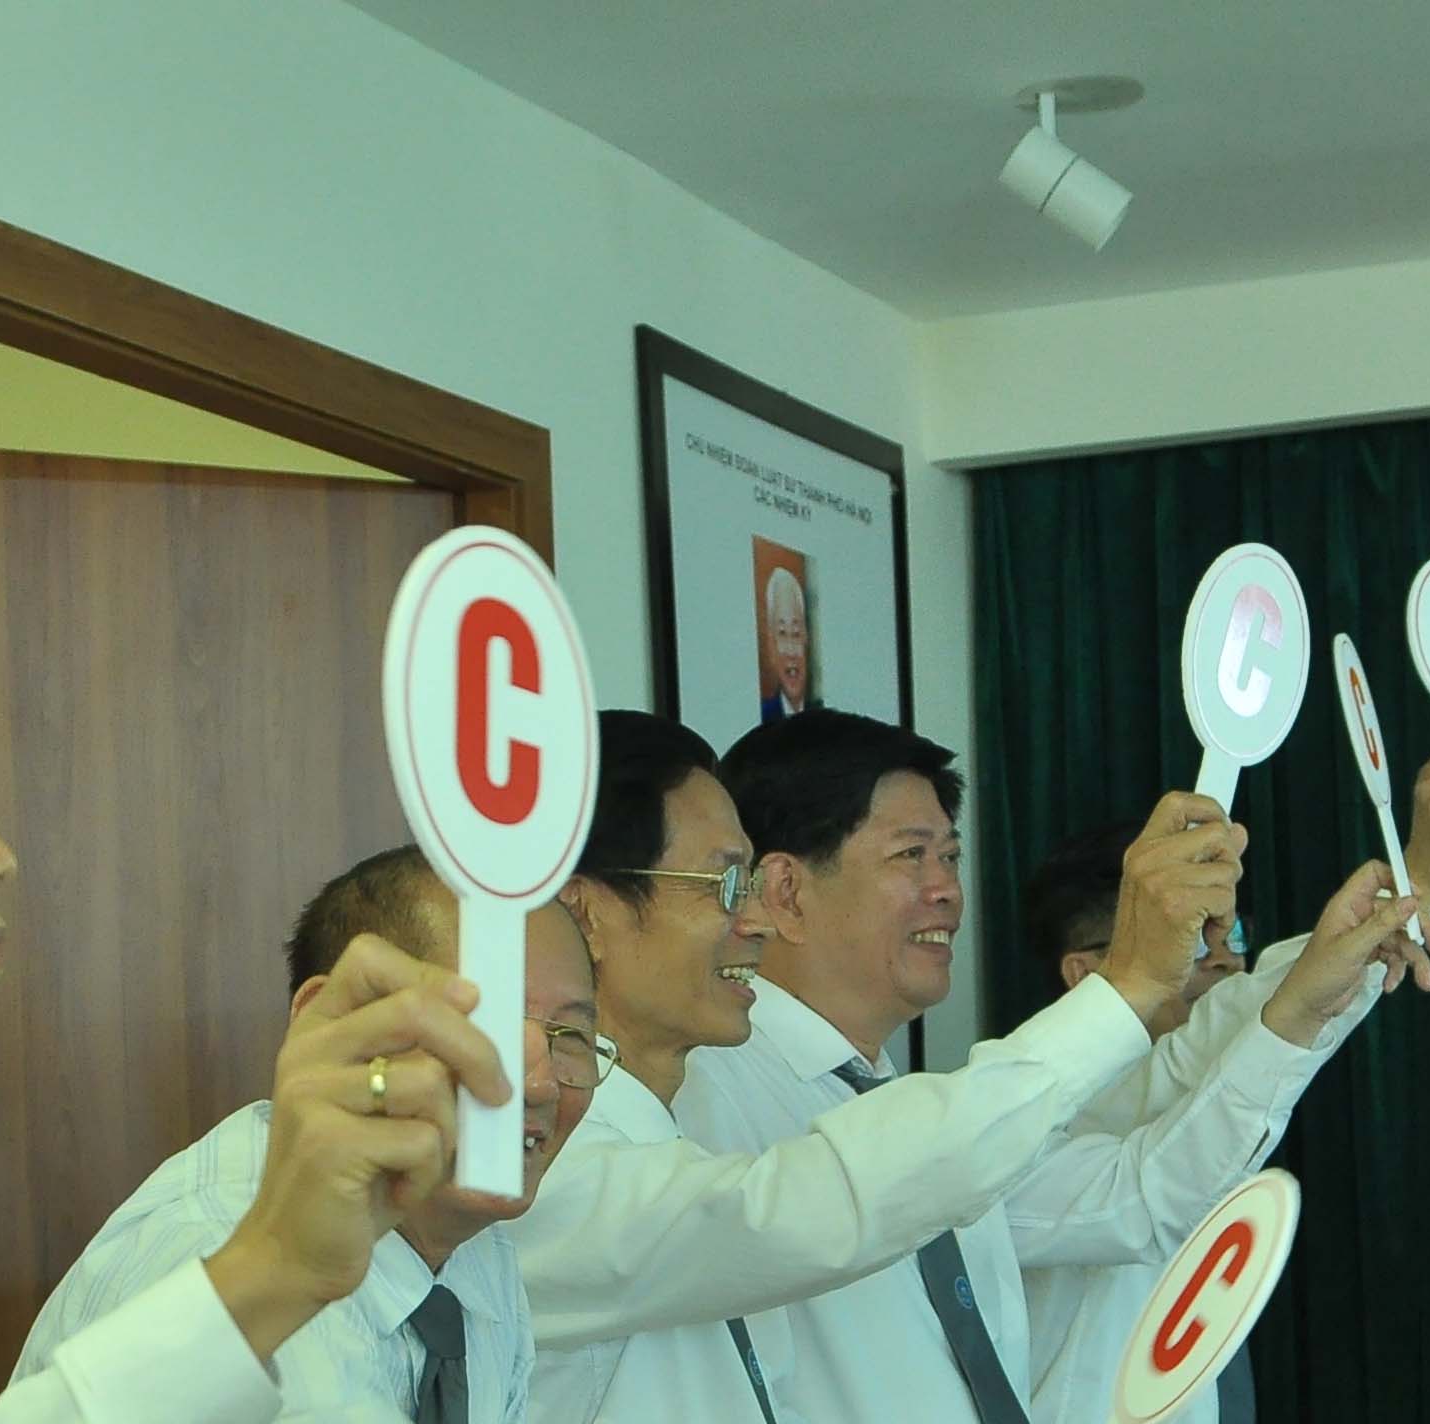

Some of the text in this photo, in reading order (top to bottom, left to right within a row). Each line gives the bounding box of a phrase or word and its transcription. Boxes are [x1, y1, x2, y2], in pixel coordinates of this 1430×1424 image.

[455, 596, 543, 826] C
[1218, 583, 1283, 718] C
[1150, 1219, 1256, 1375] C
